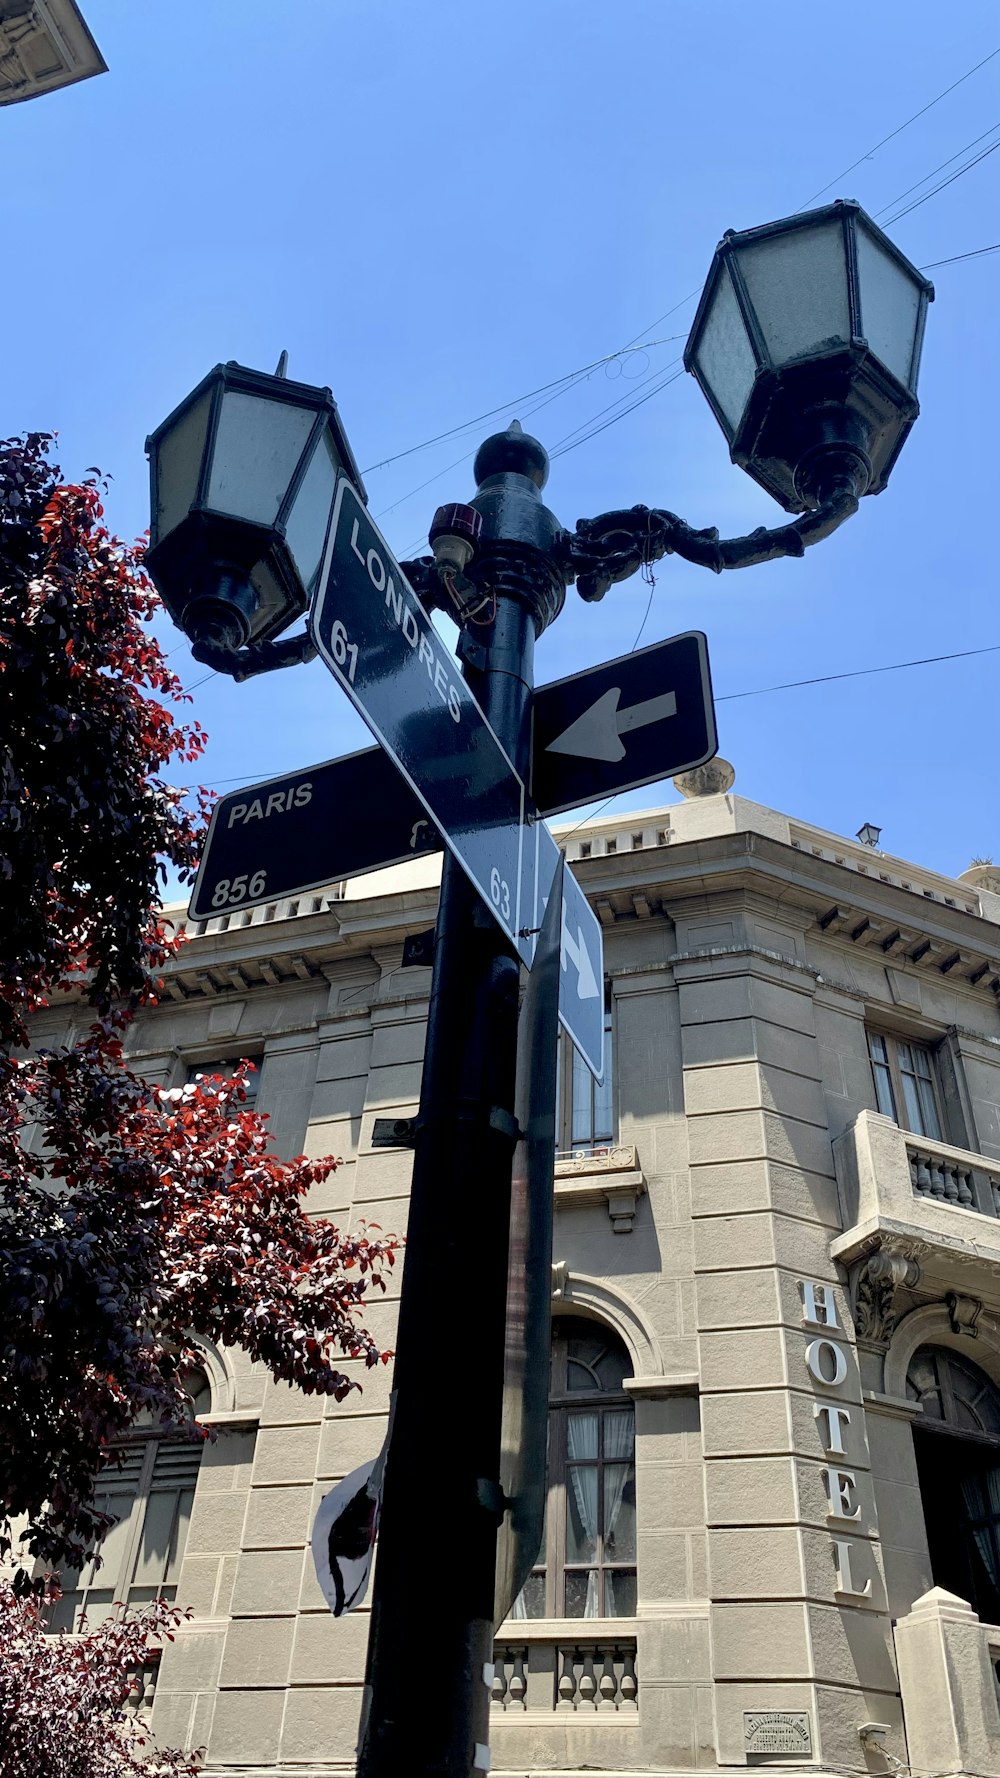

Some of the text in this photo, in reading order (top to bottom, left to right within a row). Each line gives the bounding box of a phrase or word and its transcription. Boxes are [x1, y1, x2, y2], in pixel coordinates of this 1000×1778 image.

[350, 518, 461, 724] LONDRES
[330, 619, 359, 684] 61
[227, 782, 313, 829] PARIS
[211, 869, 268, 908] 856
[490, 866, 511, 921] 63
[797, 1278, 872, 1598] HOTEL
